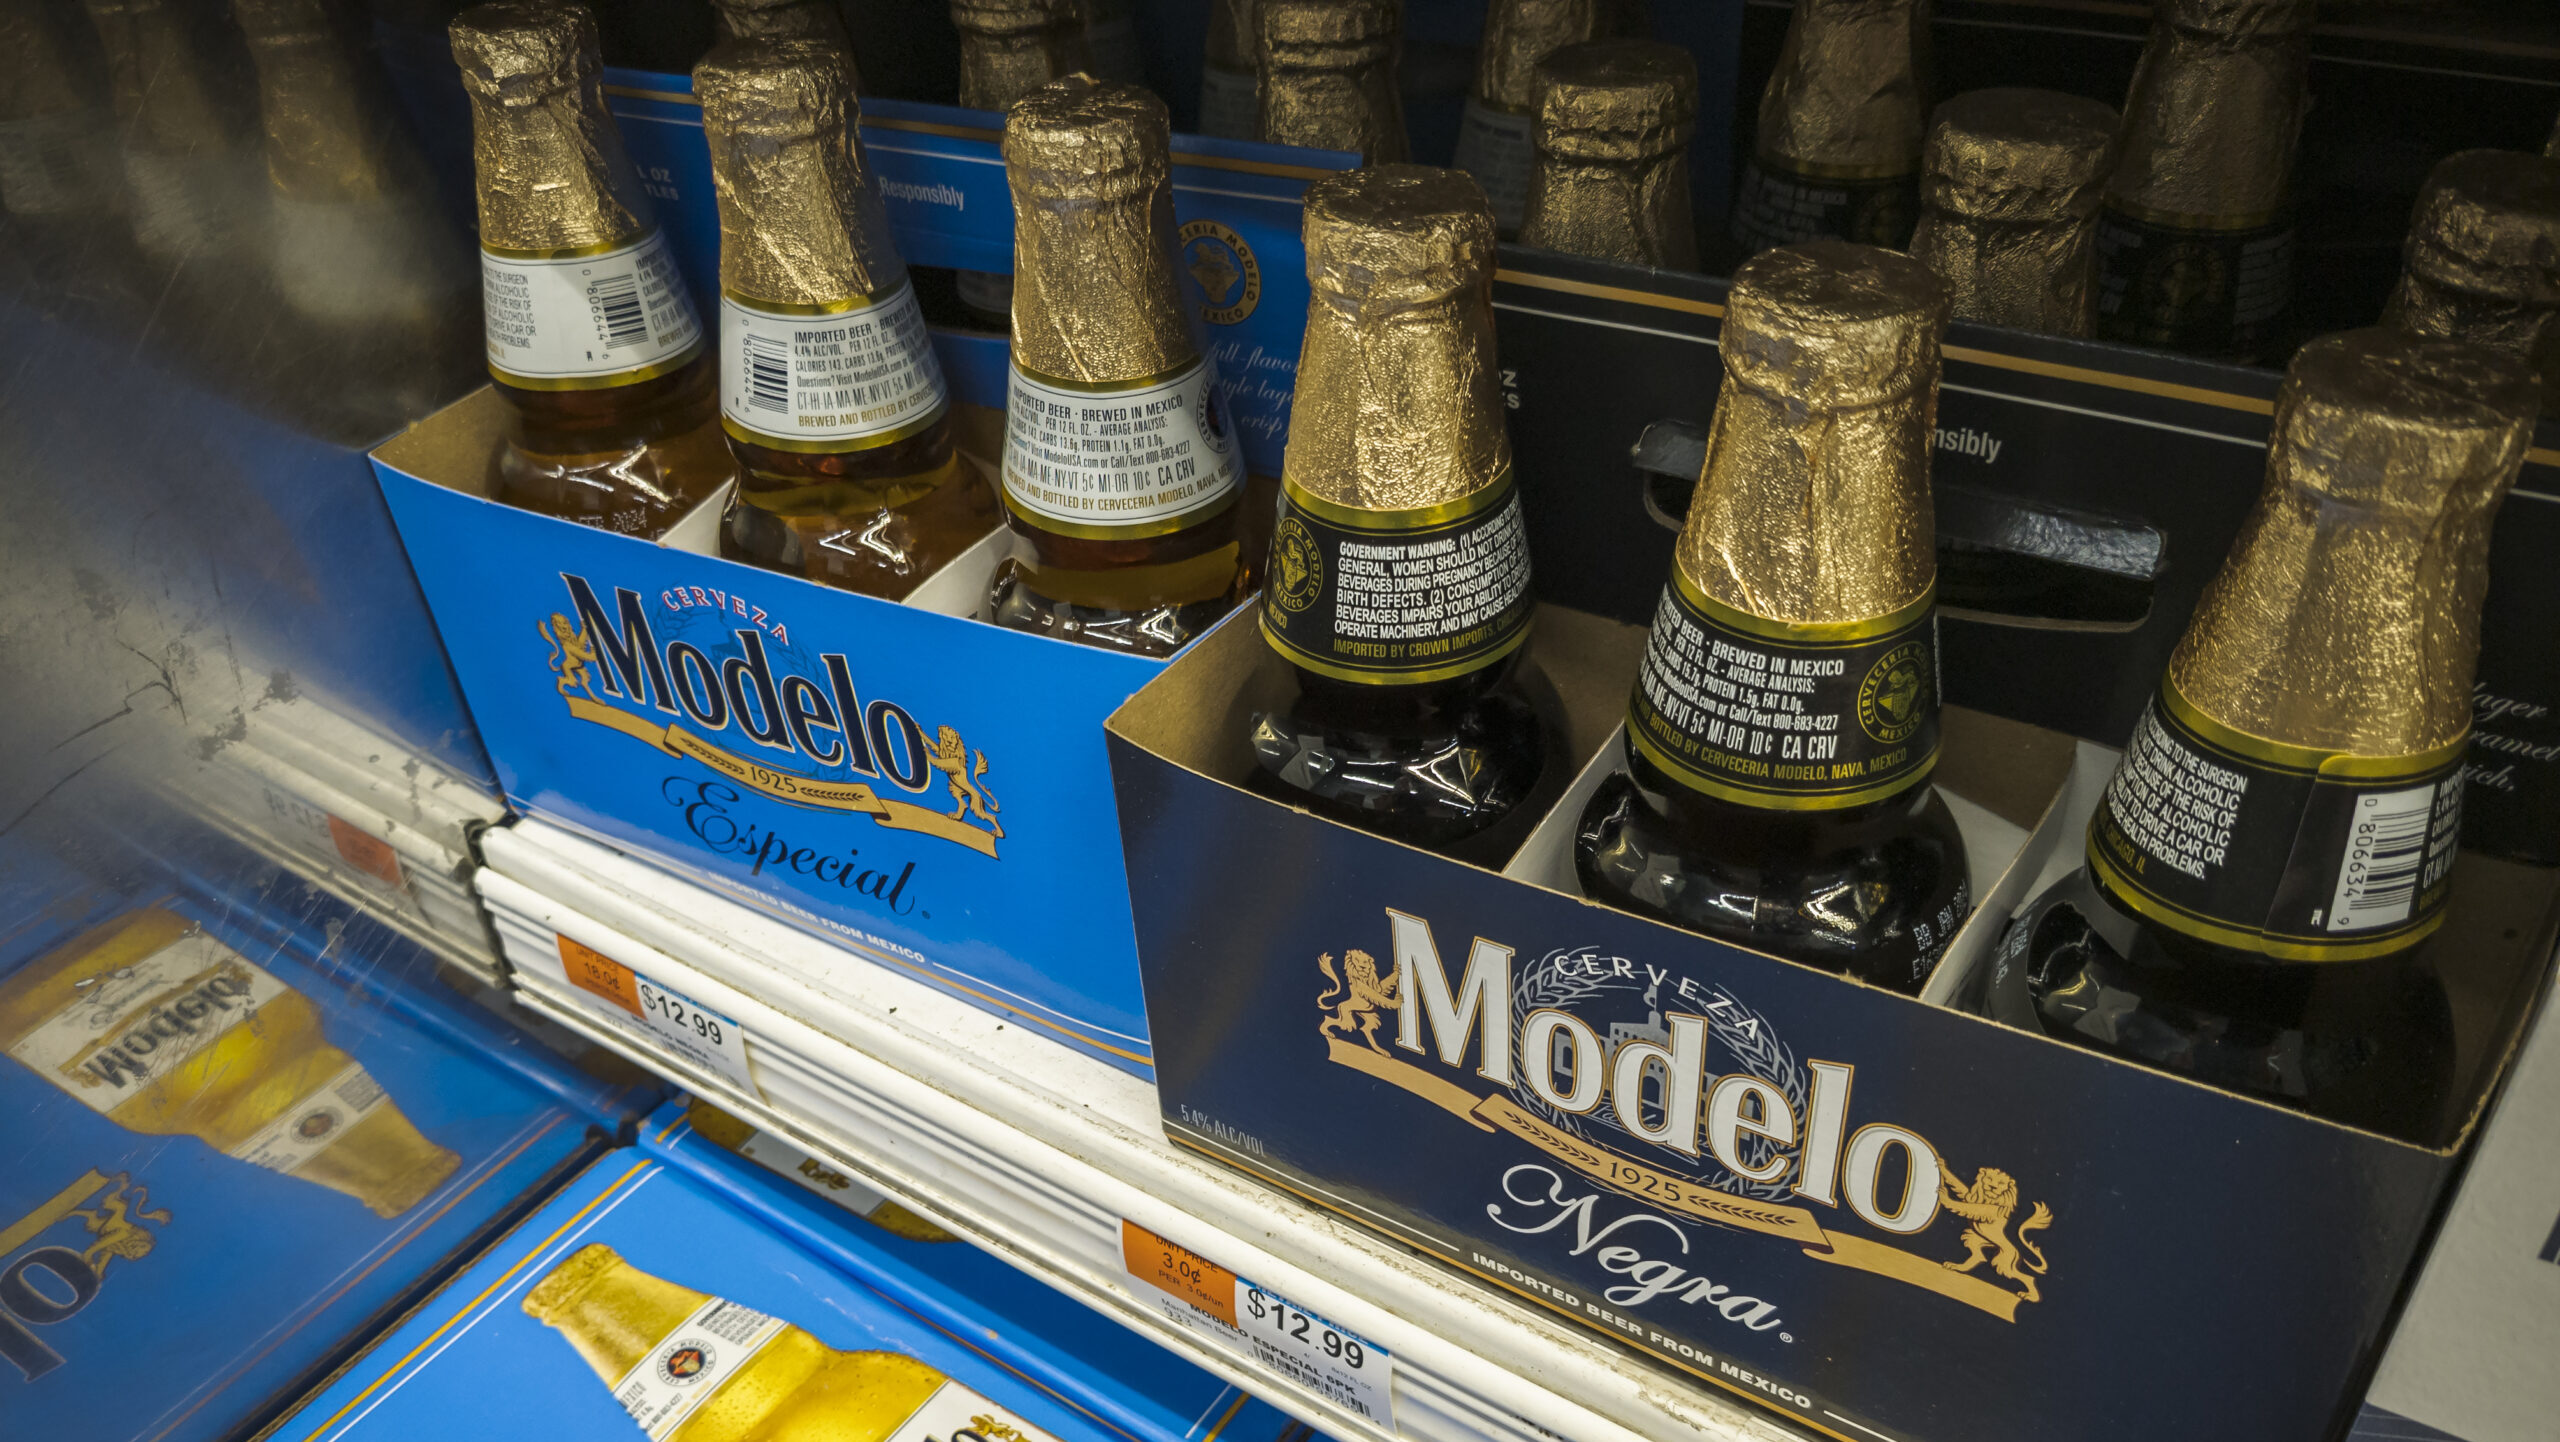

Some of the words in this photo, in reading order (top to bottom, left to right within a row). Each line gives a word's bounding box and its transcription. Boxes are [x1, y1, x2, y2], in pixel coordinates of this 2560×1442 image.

[794, 329, 846, 344] IMPORTED
[849, 323, 872, 339] BEER
[849, 340, 862, 353] PER
[796, 375, 835, 388] Questions?
[798, 415, 836, 427] BREWED
[839, 413, 859, 426] AND
[861, 403, 897, 423] BOTTLED
[1045, 416, 1057, 431] PER
[1059, 421, 1067, 434] 12
[1100, 423, 1132, 437] AVERAGE
[1133, 416, 1168, 434] ANALYSIS:
[1049, 403, 1071, 420] BEER
[1082, 408, 1127, 422] BREWED
[1131, 406, 1142, 420] IN
[1146, 394, 1184, 416] MEXICO
[1044, 448, 1098, 469] ModeloUSA.com
[1100, 458, 1108, 468] or
[1110, 453, 1145, 468] Call/Text
[1146, 440, 1191, 463] 800-683-4227
[1082, 439, 1111, 453] PROTEIN
[1133, 436, 1145, 450] FAT
[1933, 428, 2002, 464] nsibly
[1158, 465, 1174, 487] CA
[1176, 456, 1196, 482] CRV
[1043, 489, 1079, 509] BOTTLED
[1082, 497, 1095, 510] BY
[1098, 495, 1155, 511] CERVECERIA
[1338, 557, 1390, 578] GENERAL,
[1392, 560, 1435, 577] WOMEN
[1436, 547, 1476, 572] SHOULD
[1477, 538, 1494, 560] NOT
[1494, 525, 1512, 549] DRINK
[1339, 541, 1406, 561] GOVERNMENT
[1407, 538, 1456, 560] WARNING:
[1460, 533, 1471, 550] (1)
[1337, 572, 1393, 593] BEVERAGES
[1394, 575, 1432, 592] DURING
[1432, 561, 1484, 588] PREGNANCY
[1484, 544, 1512, 571] BECAUSE
[1337, 588, 1368, 607] BIRTH
[1371, 592, 1427, 608] DEFECTS.
[1430, 589, 1445, 608] (2)
[1447, 561, 1509, 599] CONSUMPTION
[661, 585, 790, 646] CERVEZA
[1334, 619, 1378, 638] OPERATE
[1380, 621, 1440, 639] MACHINERY,
[1440, 618, 1460, 635] AND
[1461, 610, 1479, 629] MAY
[1480, 597, 1504, 622] CAUSE
[1336, 604, 1399, 624] BEVERAGES
[1401, 604, 1444, 623] IMPAIRS
[1445, 594, 1474, 616] YOUR
[1474, 583, 1502, 608] ABILITY
[1334, 638, 1386, 658] IMPORTED
[1390, 644, 1406, 658] BY
[1409, 638, 1450, 657] CROWN
[1681, 619, 1704, 647] BEER
[1711, 640, 1766, 671] BREWED
[1770, 656, 1786, 675] IN
[1790, 659, 1844, 677] MEXICO
[560, 571, 931, 794] Modelo
[1702, 674, 1737, 700] PROTEIN
[1762, 692, 1779, 709] FAT
[1706, 655, 1718, 675] OZ.
[1726, 664, 1767, 688] AVERAGE
[1768, 674, 1815, 693] ANALYSIS:
[1717, 702, 1728, 717] or
[1729, 704, 1772, 728] Call/Text
[1773, 714, 1839, 731] 800-683-4227
[1685, 739, 1699, 757] BY
[1701, 746, 1769, 778] CERVECERIA
[1870, 747, 1907, 773] MEXICO
[1707, 718, 1745, 752] MI-OR
[1781, 735, 1801, 760] CA
[1807, 735, 1838, 760] CRV
[750, 766, 798, 795] 1925
[2150, 748, 2176, 778] DRINK
[2172, 767, 2240, 811] ALCOHOLIC
[2182, 751, 2199, 773] THE
[2198, 761, 2248, 793] SURGEON
[2159, 803, 2231, 847] ALCOHOLIC
[2173, 788, 2193, 813] THE
[2191, 798, 2220, 824] RISK
[2218, 811, 2237, 829] OF
[661, 775, 917, 918] Especial
[2139, 808, 2169, 840] DRIVE
[2176, 833, 2202, 858] CAR
[2203, 848, 2225, 867] OR
[2148, 837, 2206, 880] PROBLEMS.
[2343, 823, 2376, 898] 806634
[708, 871, 778, 906] IMPORTED
[781, 901, 818, 924] BEER
[821, 917, 864, 940] FROM
[866, 933, 925, 963] MEXICO
[641, 984, 723, 1046] $12.99
[1553, 952, 1762, 1042] CERVEZA
[1386, 906, 1943, 1236] Modelo
[1181, 1103, 1212, 1133] 5.4%
[1606, 1159, 1682, 1206] 1925
[1163, 1252, 1201, 1284] 3.0¢
[1486, 1164, 1784, 1336] Negra
[1190, 1304, 1248, 1337] MODELO
[1253, 1336, 1322, 1378] ESPECIAL
[1247, 1288, 1364, 1369] $12.99
[1473, 1252, 1580, 1307] IMPORTED
[1586, 1303, 1643, 1337] BEER
[1650, 1331, 1713, 1367] FROM
[1720, 1361, 1812, 1410] MEXICO
